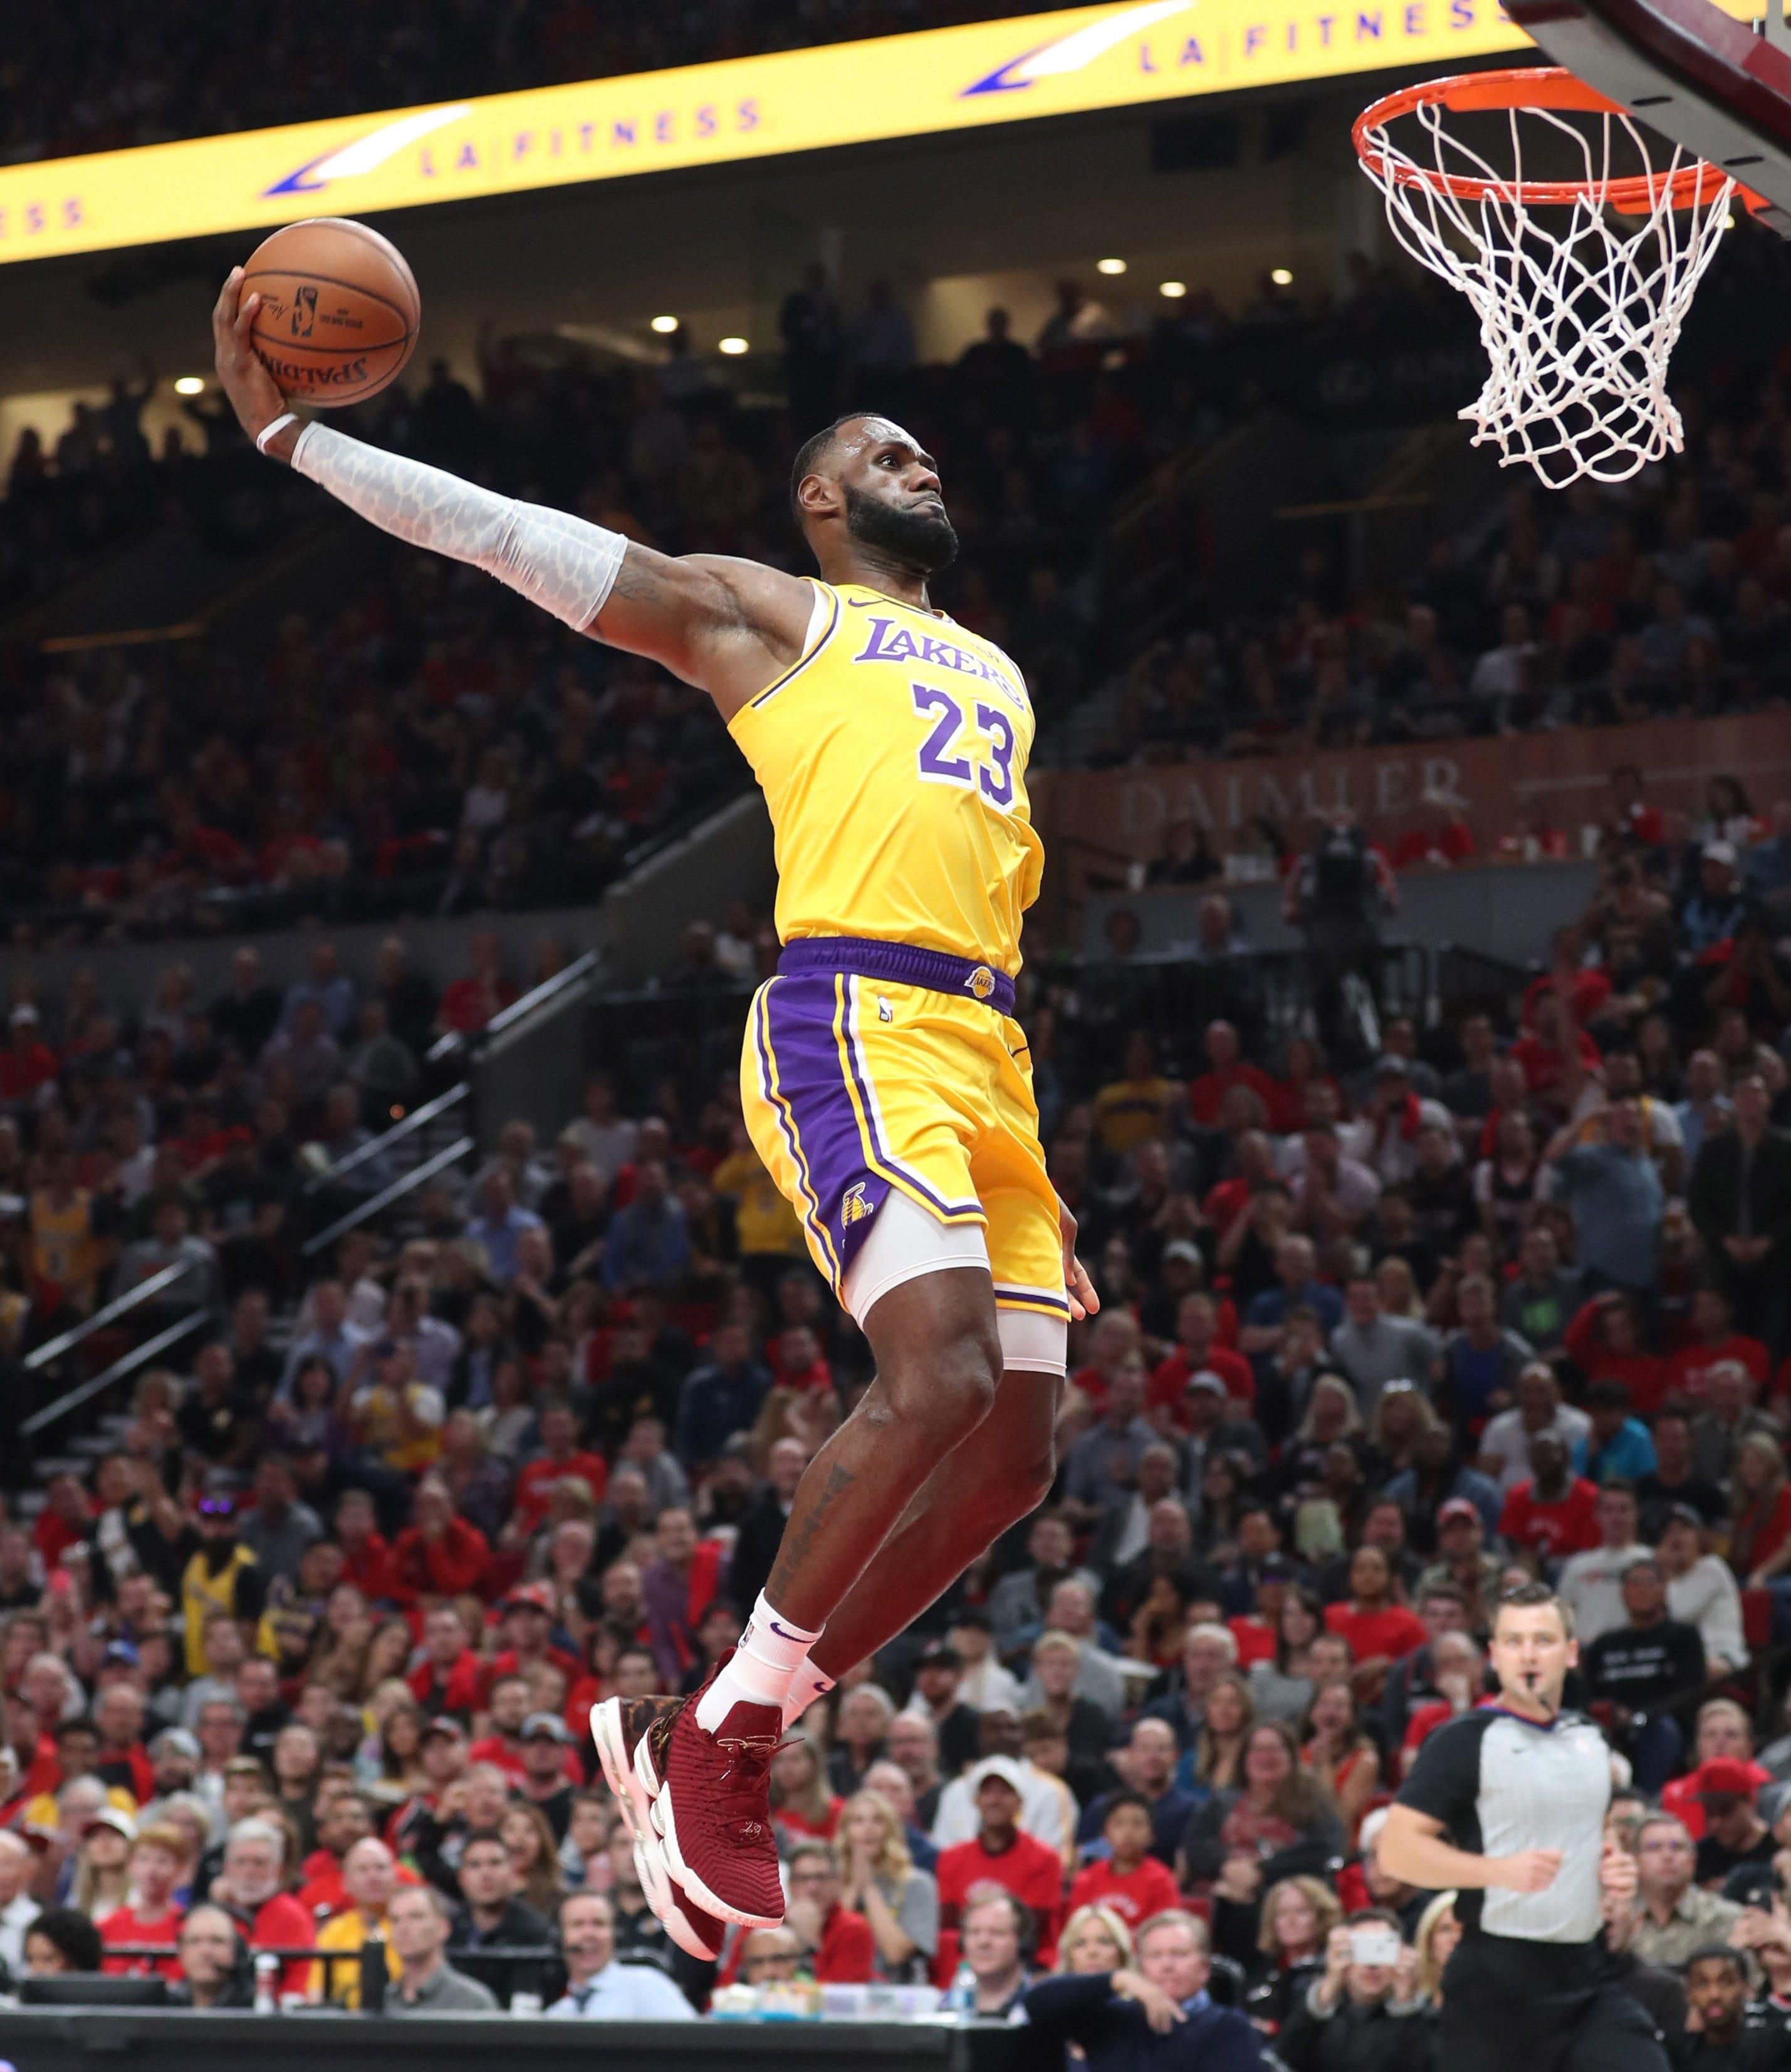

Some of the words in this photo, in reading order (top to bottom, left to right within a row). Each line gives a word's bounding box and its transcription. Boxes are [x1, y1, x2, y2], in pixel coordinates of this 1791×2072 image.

[1139, 36, 1204, 73] LA
[1245, 0, 1509, 58] FITNES
[420, 144, 479, 177] LA
[513, 100, 760, 162] FITNESS
[258, 349, 367, 385] SPALDIN
[853, 617, 1025, 711] LAKERS
[912, 683, 1015, 812] 23
